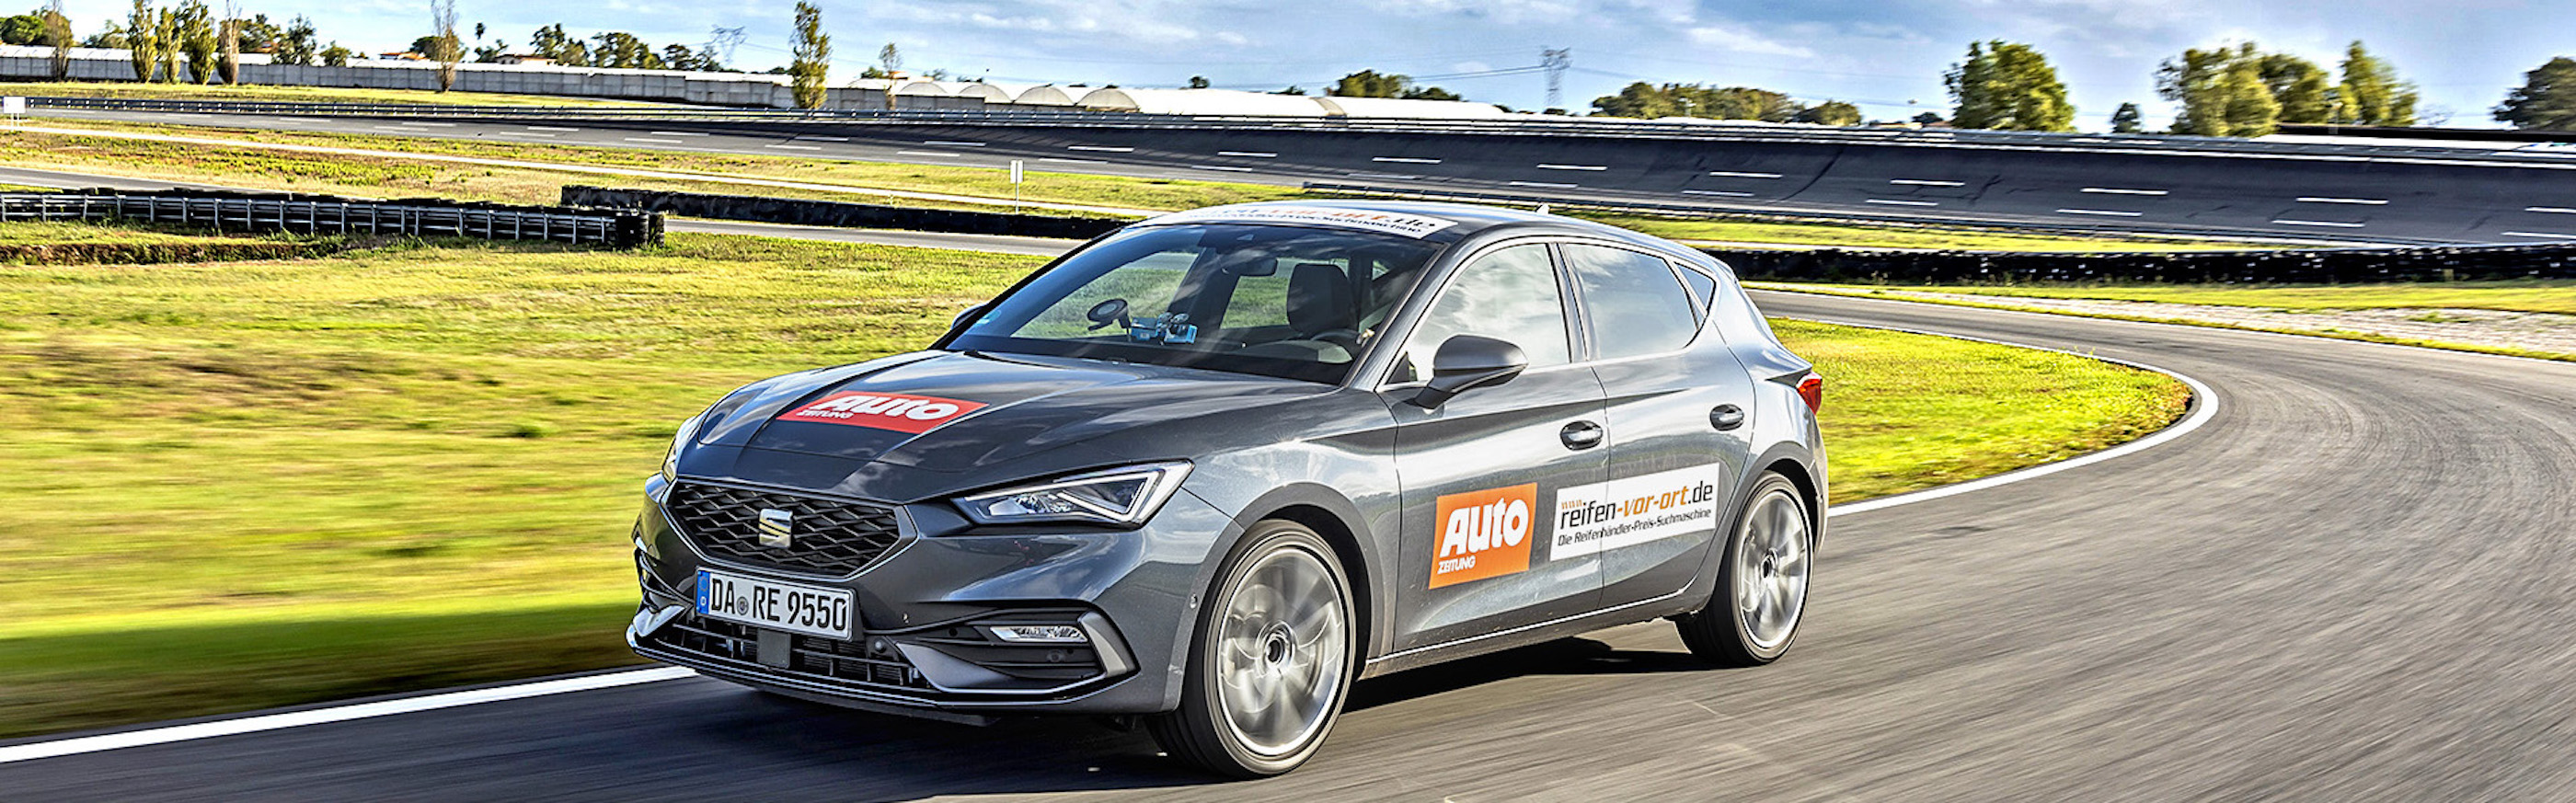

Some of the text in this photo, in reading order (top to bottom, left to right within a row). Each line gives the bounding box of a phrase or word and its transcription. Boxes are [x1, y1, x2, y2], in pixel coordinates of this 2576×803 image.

[1559, 480, 1713, 530] reifen-vor-ort.de
[1558, 534, 1572, 546] Die
[1437, 555, 1476, 575] ZEITUNG
[712, 579, 846, 631] DA RE 9550
